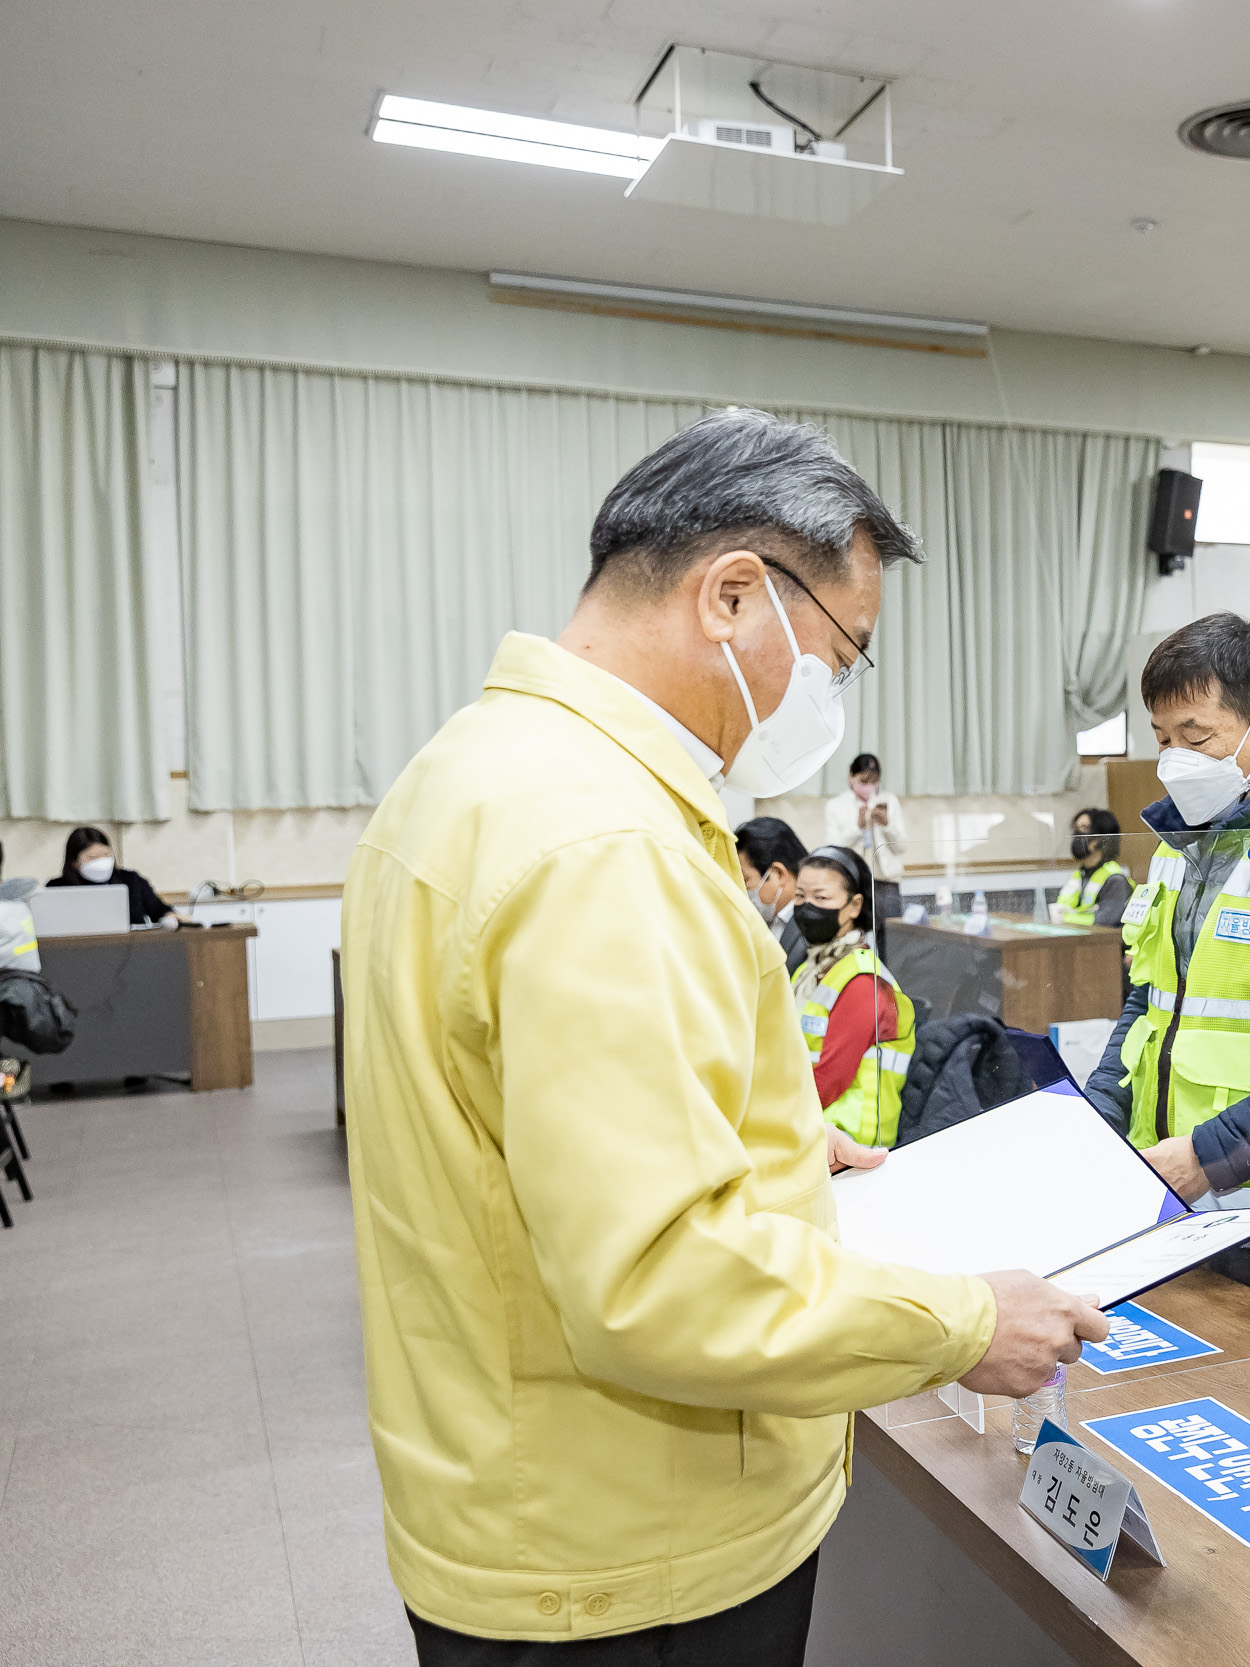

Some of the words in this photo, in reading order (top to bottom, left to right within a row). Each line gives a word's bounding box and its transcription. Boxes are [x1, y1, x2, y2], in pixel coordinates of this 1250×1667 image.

[1129, 1414, 1249, 1461] 광진구
[1053, 1448, 1075, 1474] 자양2동
[1075, 1465, 1106, 1499] 자율방범대
